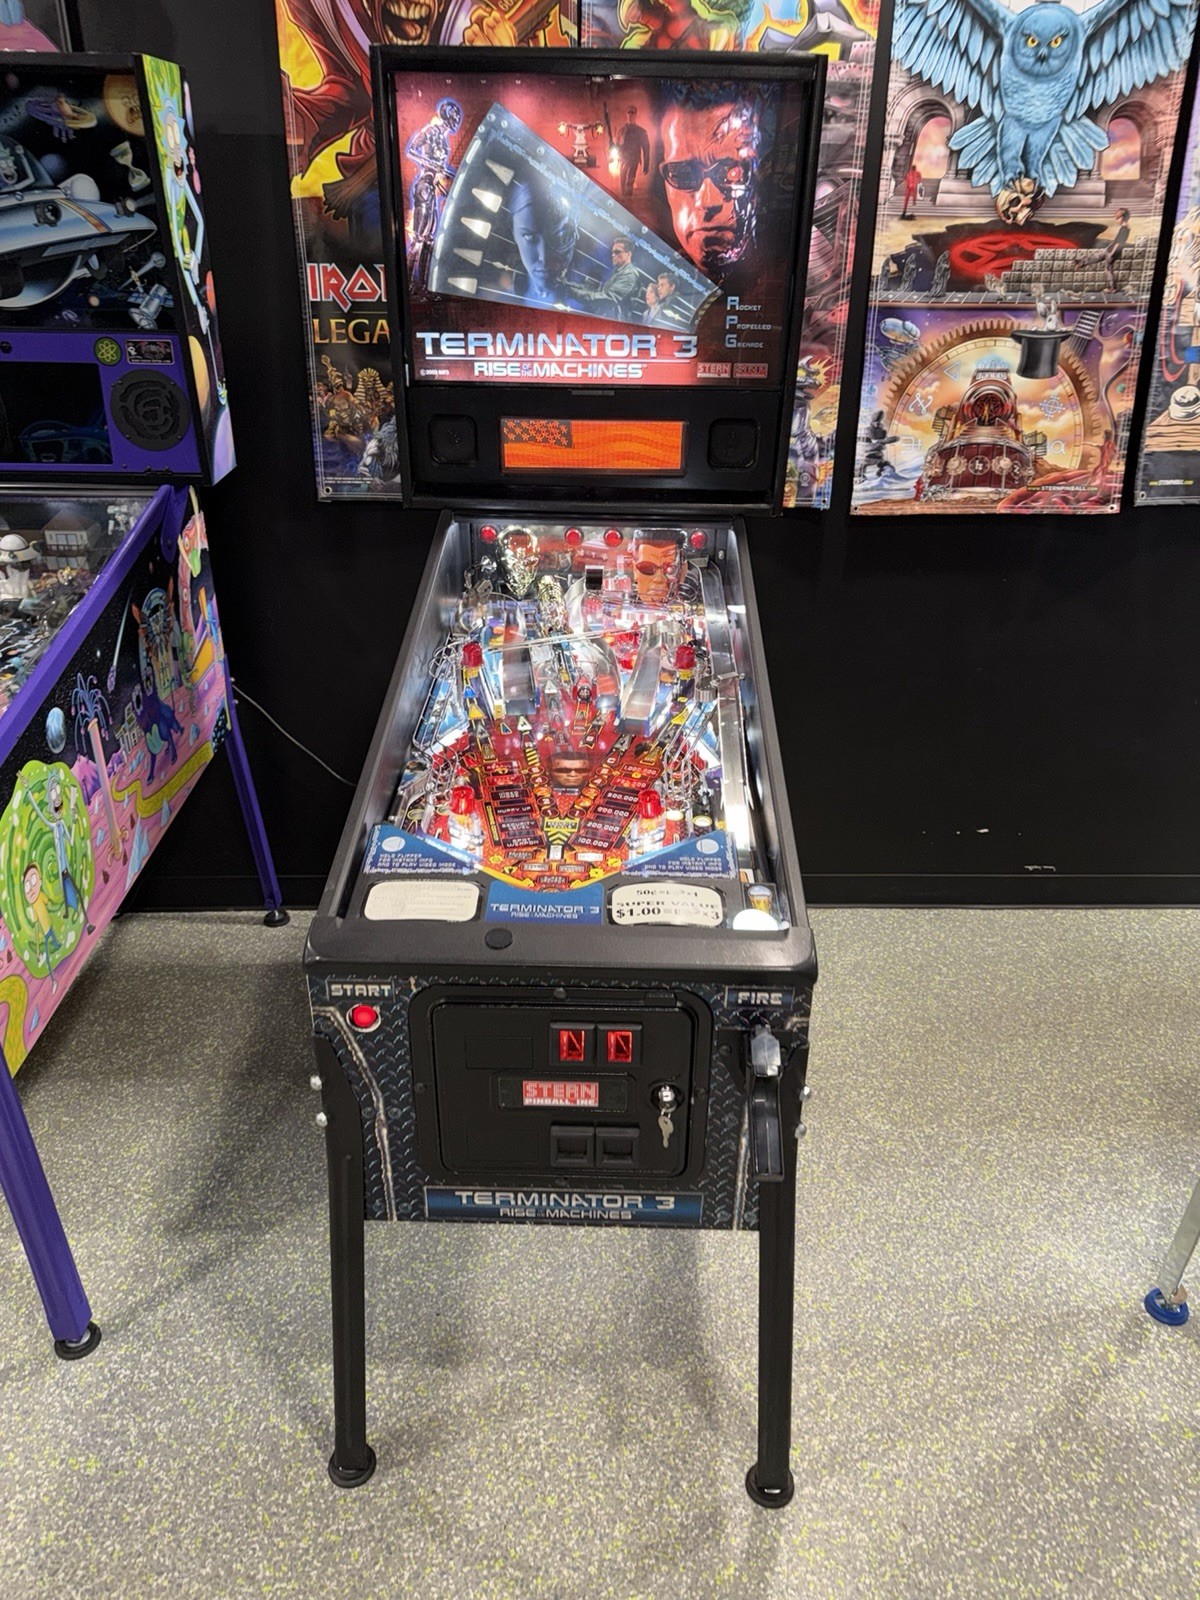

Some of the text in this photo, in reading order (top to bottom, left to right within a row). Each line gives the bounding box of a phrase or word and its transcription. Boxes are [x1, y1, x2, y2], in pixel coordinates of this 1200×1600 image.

[726, 296, 762, 311] ROCKET
[726, 315, 772, 330] PROPELLED
[415, 332, 698, 359] TERMINATOR 3
[725, 333, 764, 349] GRENADE
[473, 362, 520, 377] RISE
[533, 362, 644, 379] MACHINES
[697, 363, 731, 373] STERN
[490, 903, 600, 914] TERMINATOR 3
[330, 983, 392, 998] START
[737, 991, 783, 1005] FIRE
[523, 1081, 599, 1098] STERN
[454, 1190, 676, 1210] TERMINATOR 3
[500, 1207, 537, 1218] RISE
[545, 1209, 635, 1220] MACHINES
